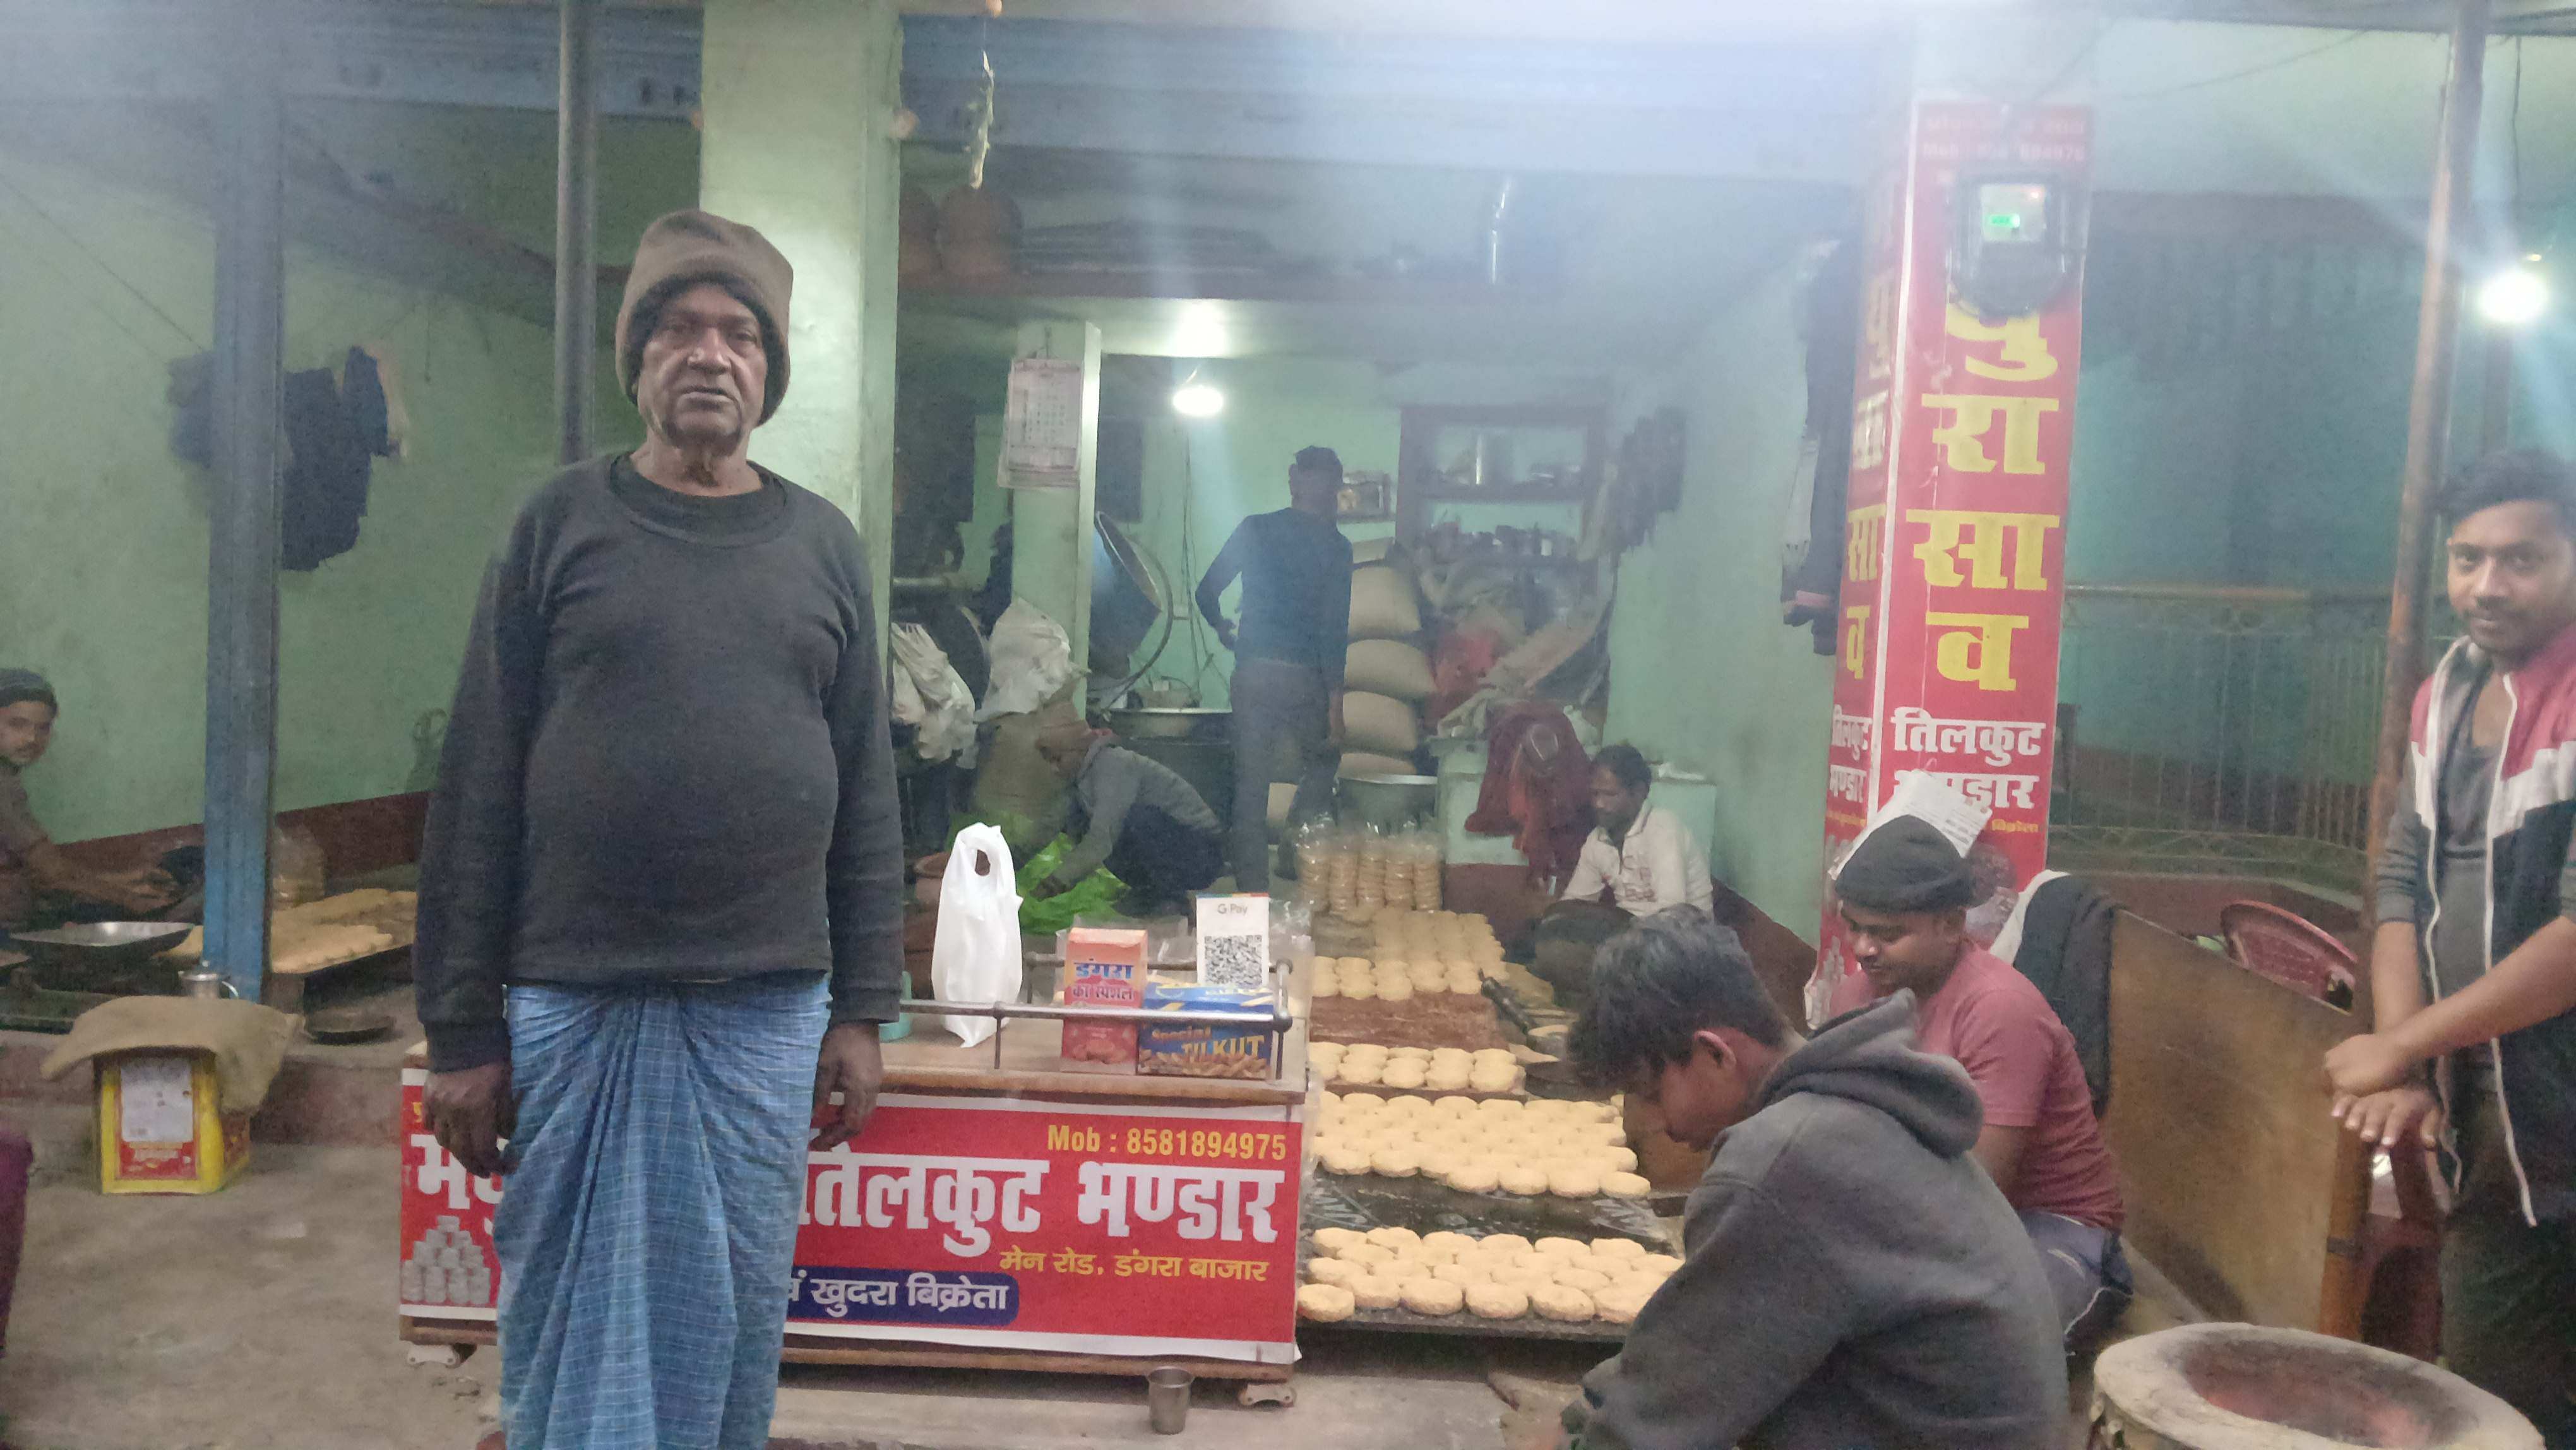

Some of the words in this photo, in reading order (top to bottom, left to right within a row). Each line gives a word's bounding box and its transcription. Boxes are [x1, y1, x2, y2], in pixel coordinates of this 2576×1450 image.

[1890, 706, 2046, 767] तिलकुट
[1217, 904, 1227, 914] G
[1230, 904, 1248, 916] Pay
[1073, 957, 1135, 979] डंगरा
[1182, 1034, 1265, 1061] TILKUT
[1047, 1125, 1100, 1153] Mob
[1126, 1127, 1287, 1160] 8581894975
[1077, 1160, 1285, 1243] भण्डार
[1000, 1245, 1046, 1273] मेन
[1114, 1249, 1183, 1277] डंगरा
[1189, 1258, 1270, 1282] बाजार
[811, 1277, 898, 1317] खुदरा
